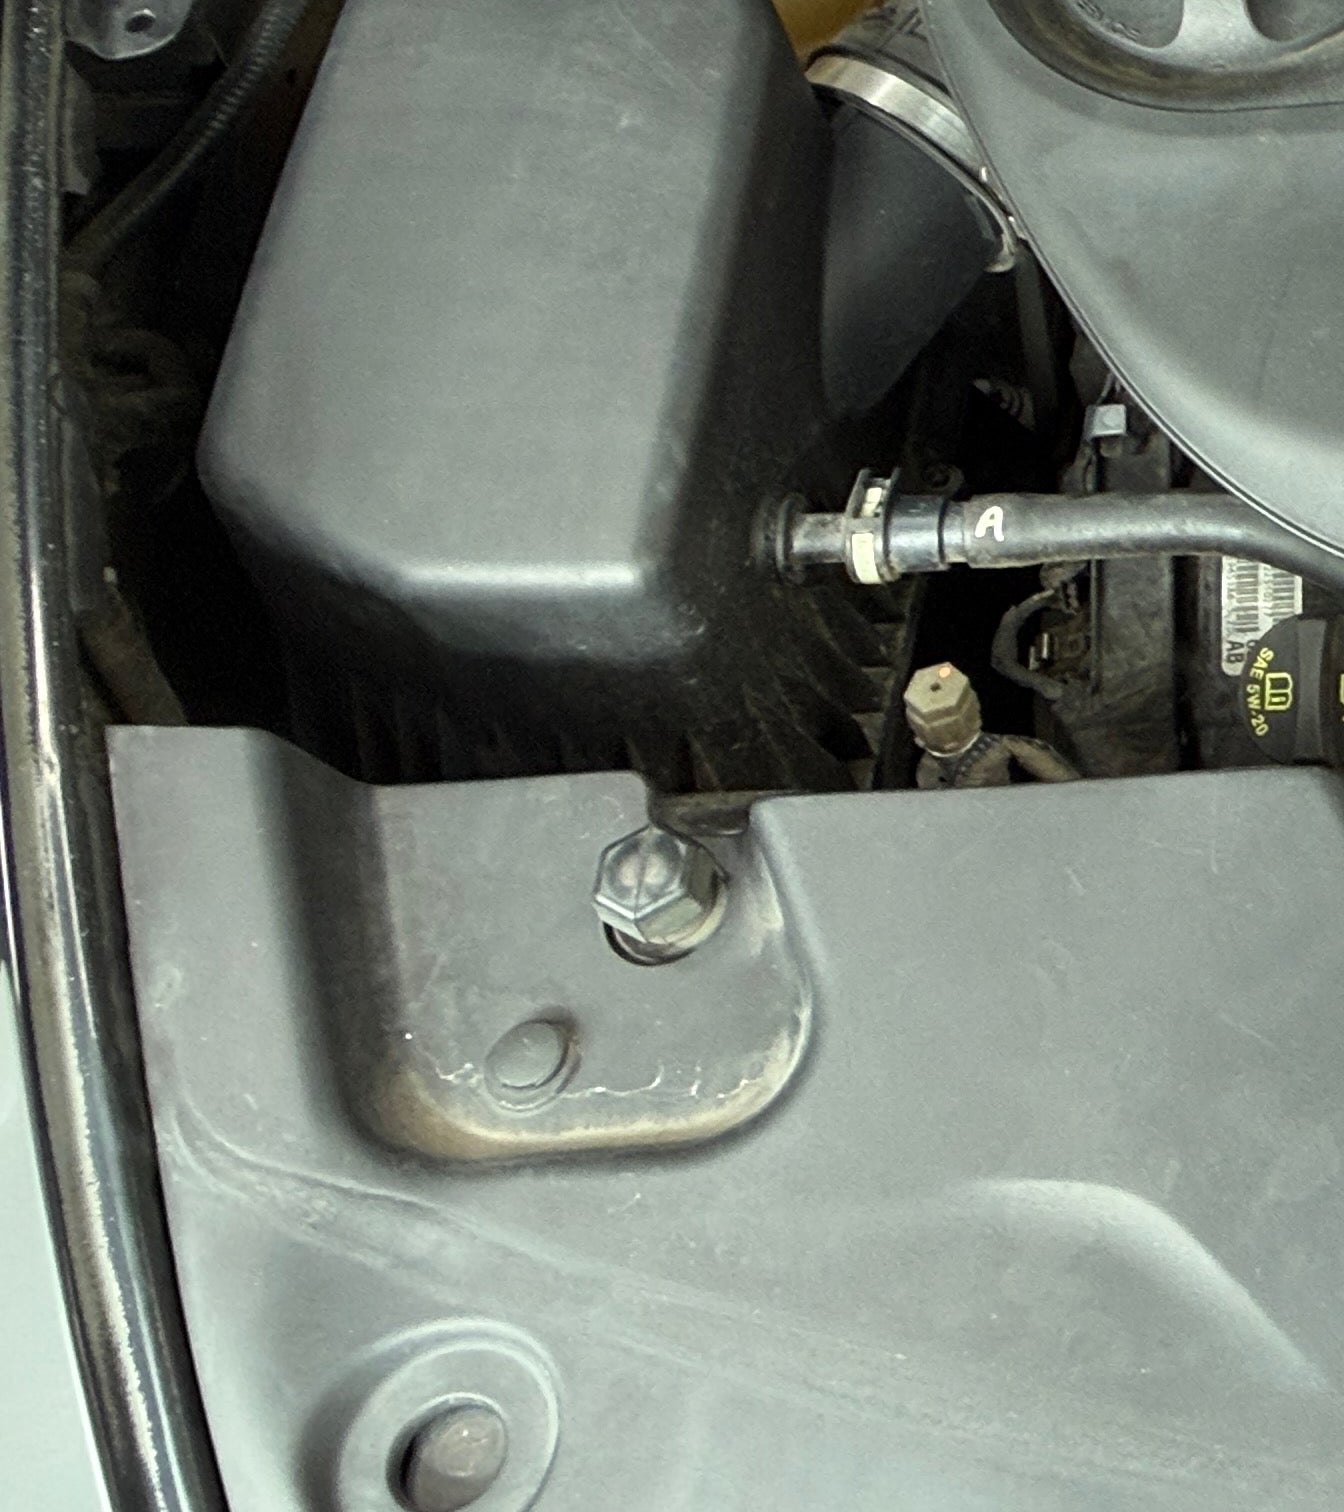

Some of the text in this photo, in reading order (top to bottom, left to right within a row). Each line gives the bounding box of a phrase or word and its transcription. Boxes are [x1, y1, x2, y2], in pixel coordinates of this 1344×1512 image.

[974, 505, 1005, 542] A
[1225, 640, 1246, 664] AB
[1249, 646, 1275, 681] SAE
[1245, 683, 1270, 737] 5W-20
